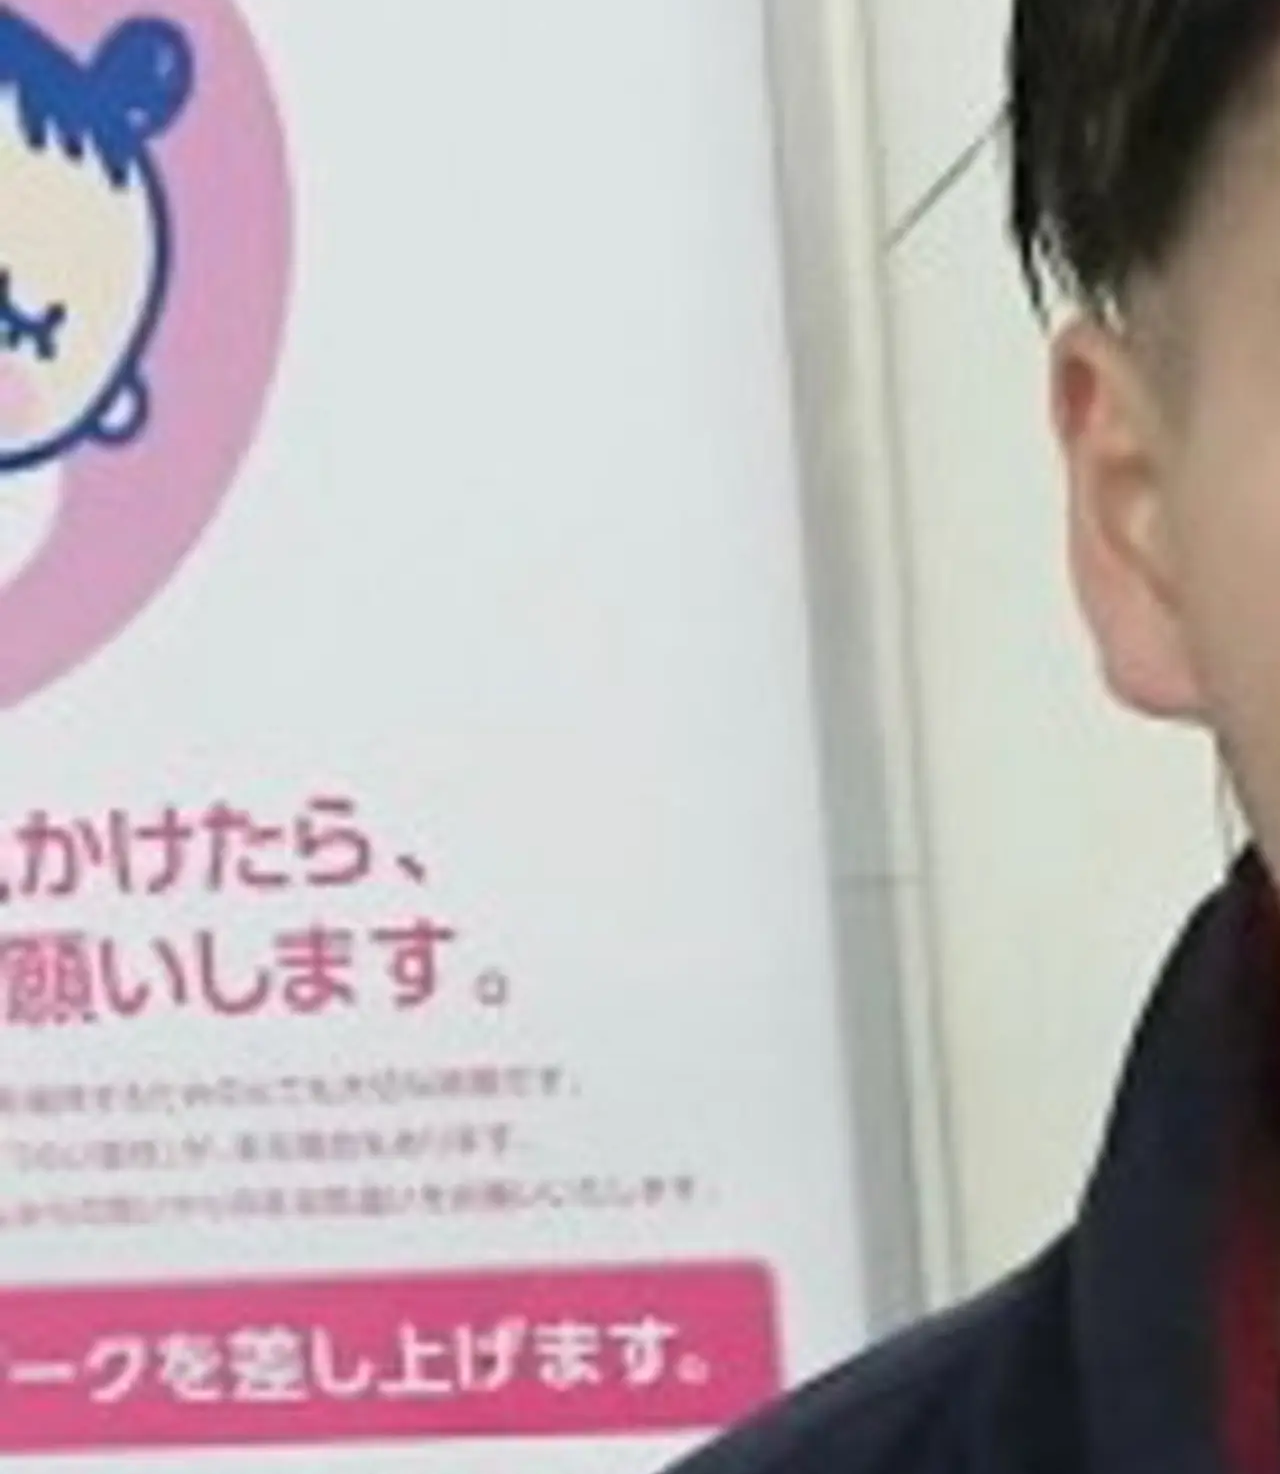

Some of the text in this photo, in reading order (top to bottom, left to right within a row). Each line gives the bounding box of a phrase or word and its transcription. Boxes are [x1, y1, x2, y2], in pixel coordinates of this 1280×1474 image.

[0, 796, 427, 906] かけたら、
[0, 922, 508, 1026] 願いします。
[8, 1315, 709, 1405] ークを差し上げます。
